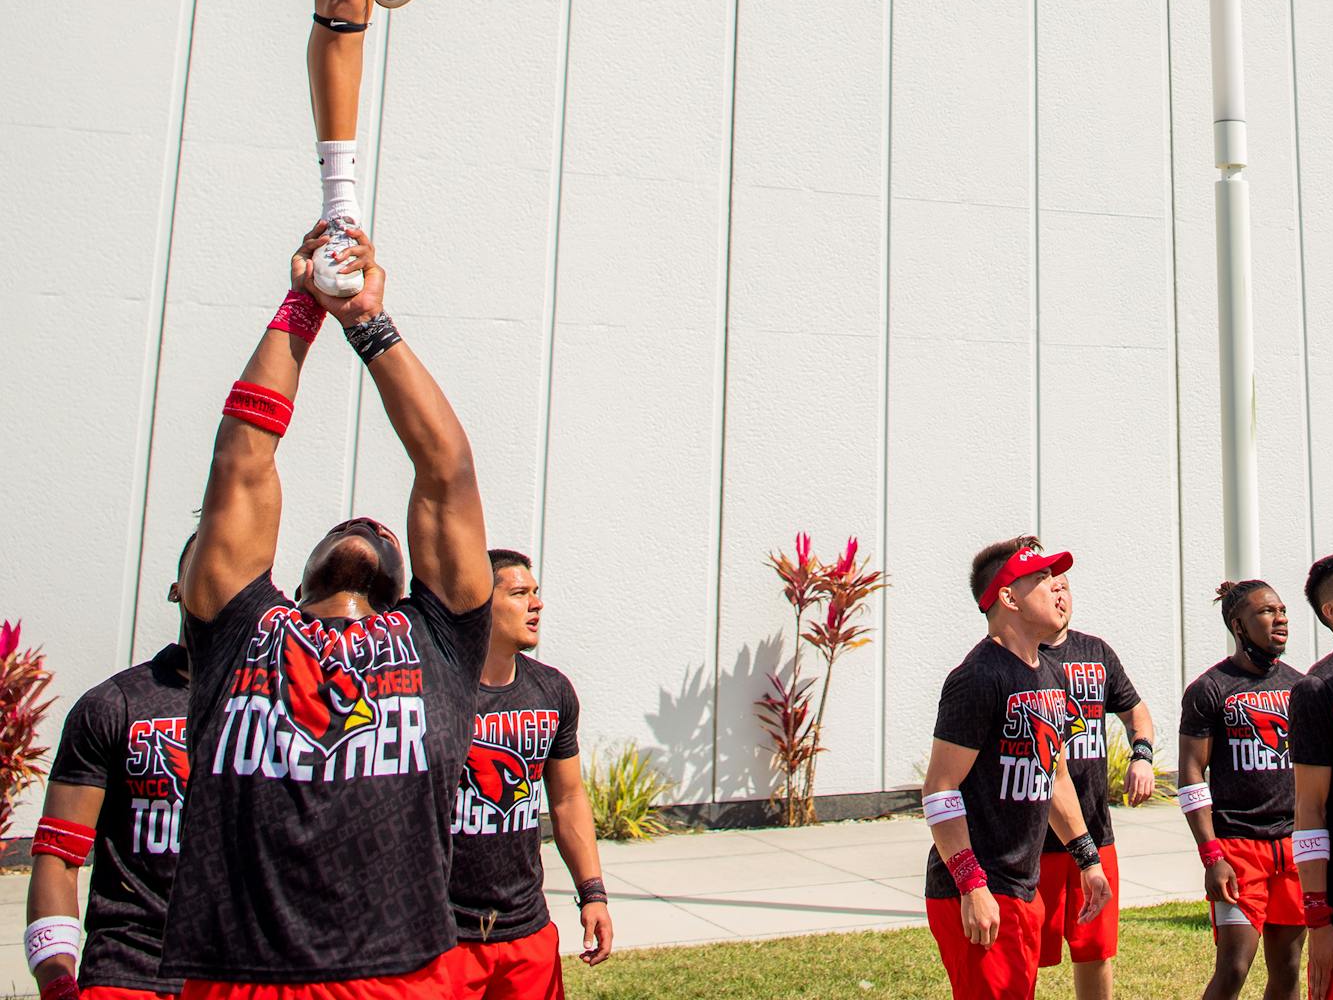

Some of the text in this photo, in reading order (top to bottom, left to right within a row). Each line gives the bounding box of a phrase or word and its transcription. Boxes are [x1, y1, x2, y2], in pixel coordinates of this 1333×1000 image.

[247, 605, 421, 673] STNGER
[365, 668, 424, 697] CHEER
[212, 695, 429, 782] TOGEHER
[1000, 739, 1032, 756] TVCC
[1228, 737, 1293, 772] TOGE
[127, 778, 169, 798] TVCC
[999, 755, 1053, 801] TOGE
[1298, 836, 1322, 850] CCFC
